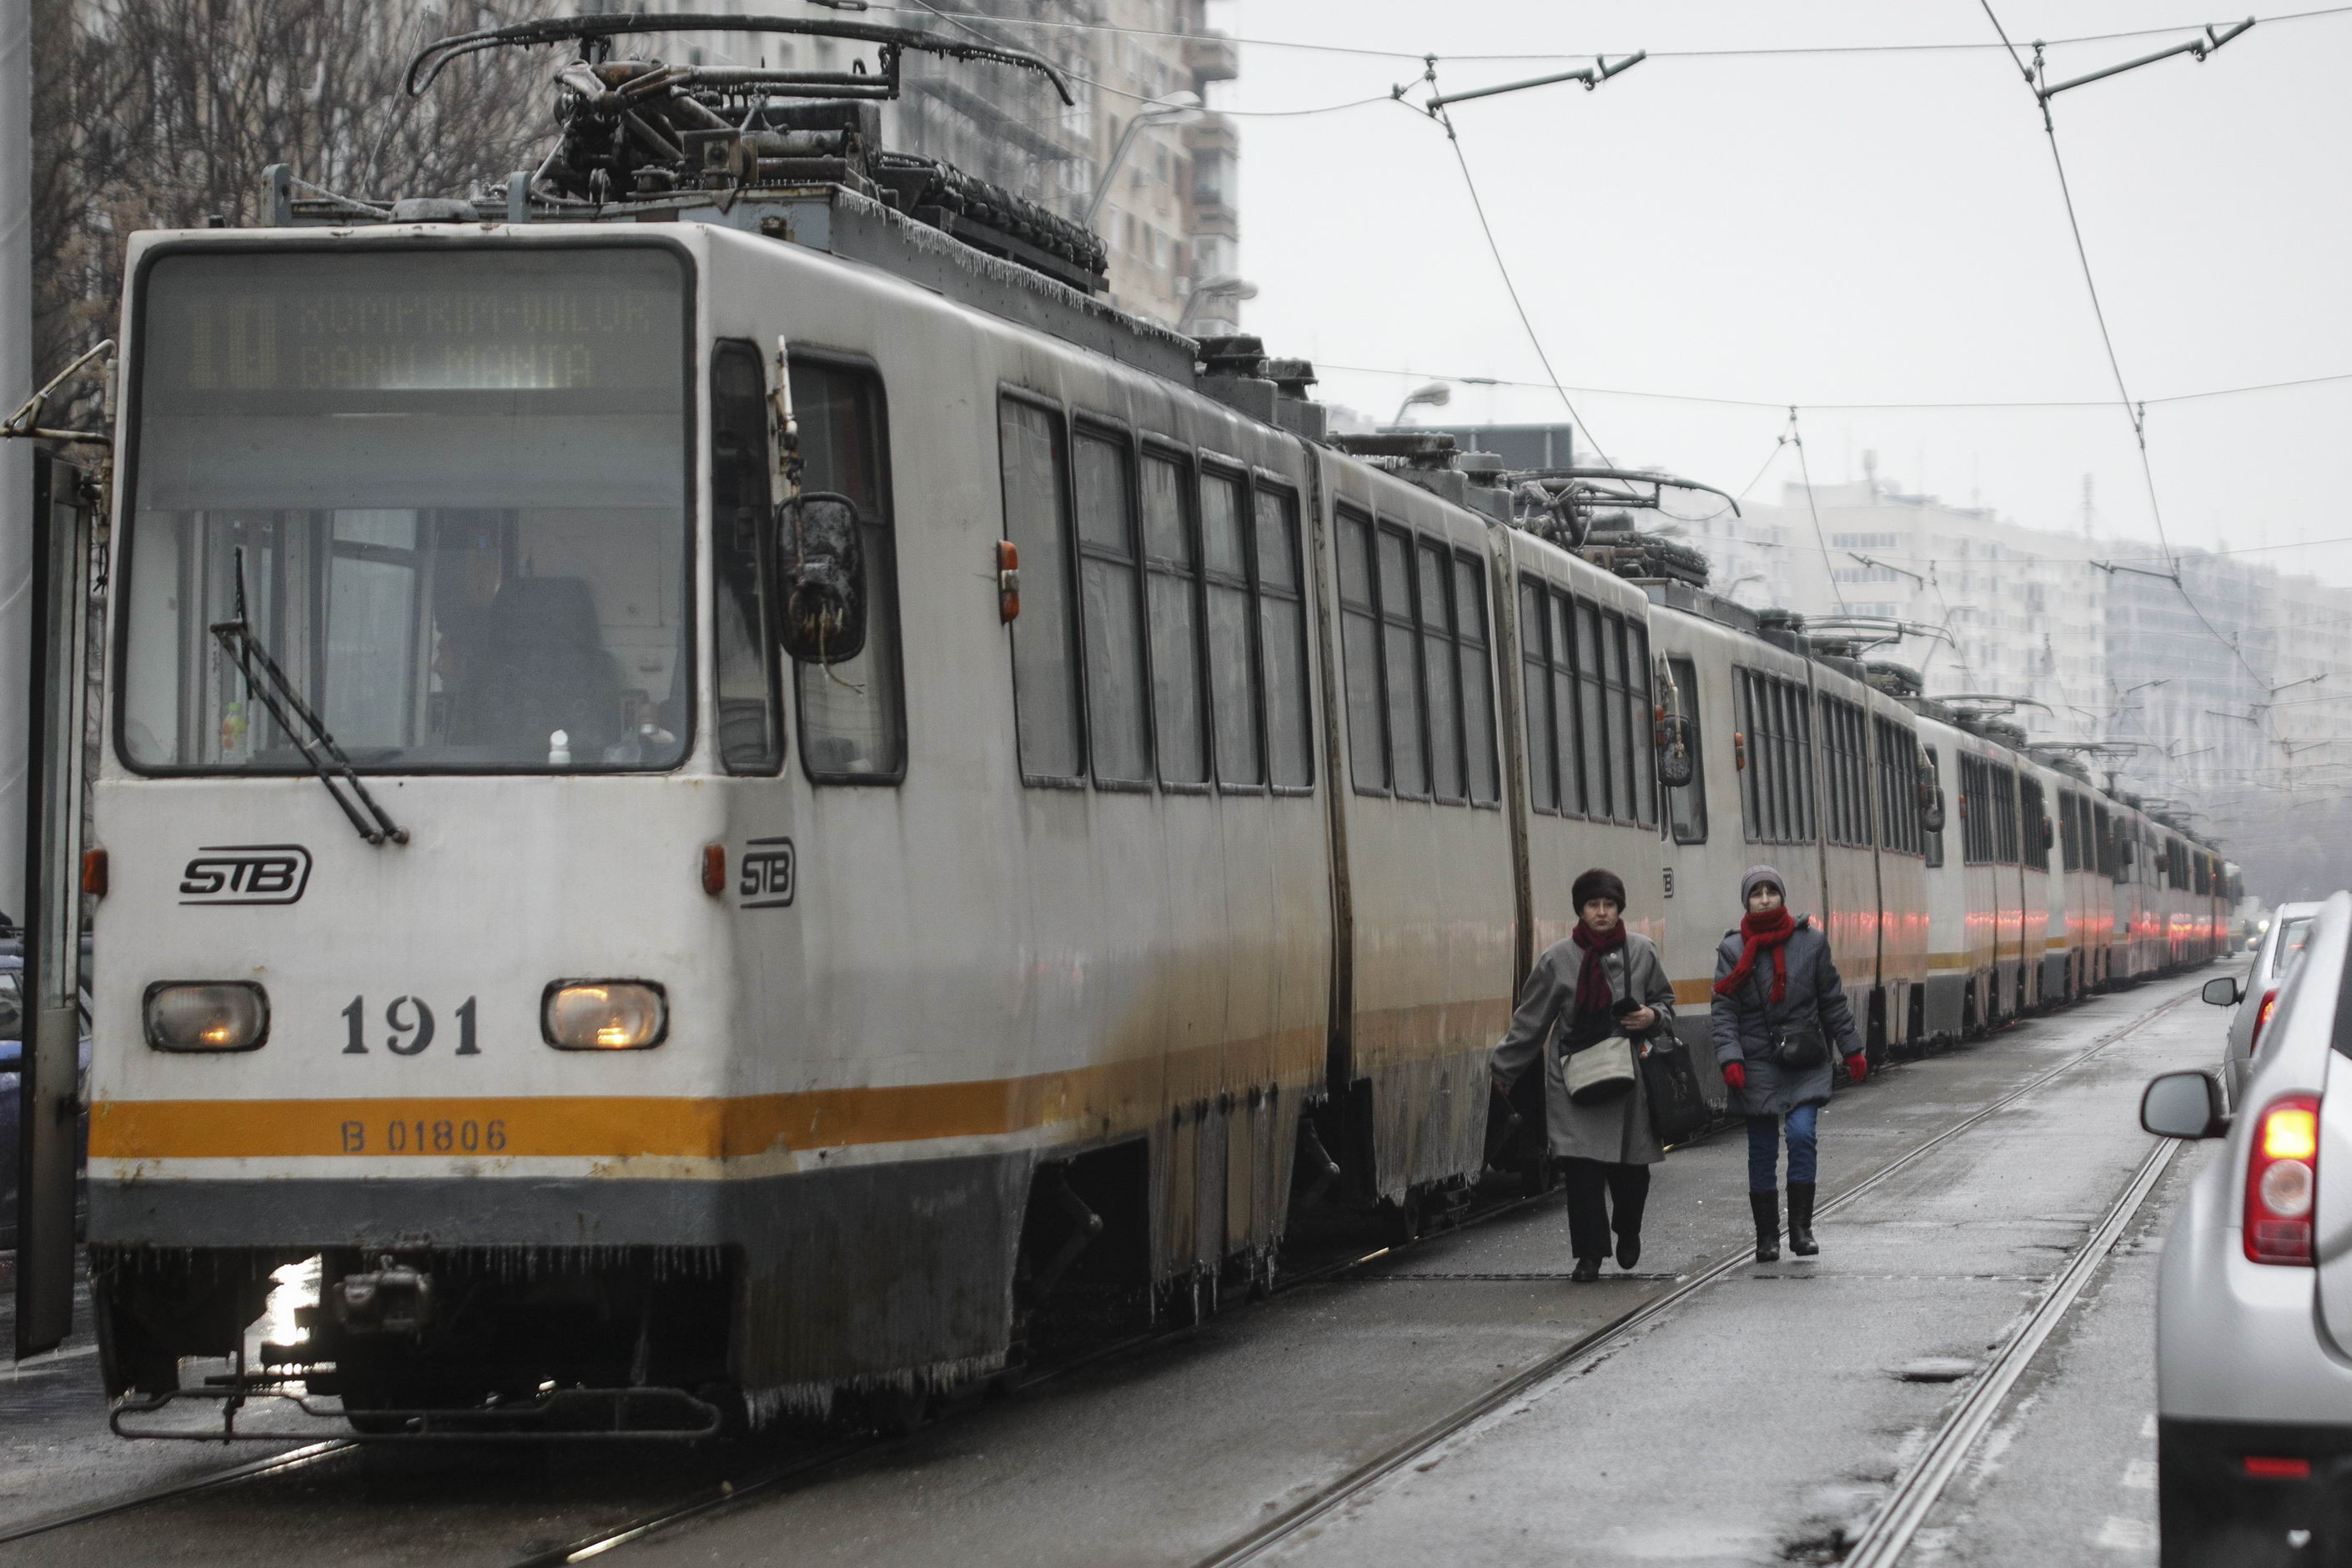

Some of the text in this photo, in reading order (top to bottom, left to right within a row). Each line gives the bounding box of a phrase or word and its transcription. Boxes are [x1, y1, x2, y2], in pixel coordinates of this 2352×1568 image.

[185, 294, 276, 389] 10
[178, 857, 299, 894] STB
[739, 851, 791, 894] STB
[341, 995, 483, 1056] 191
[340, 1119, 508, 1153] B 01806
